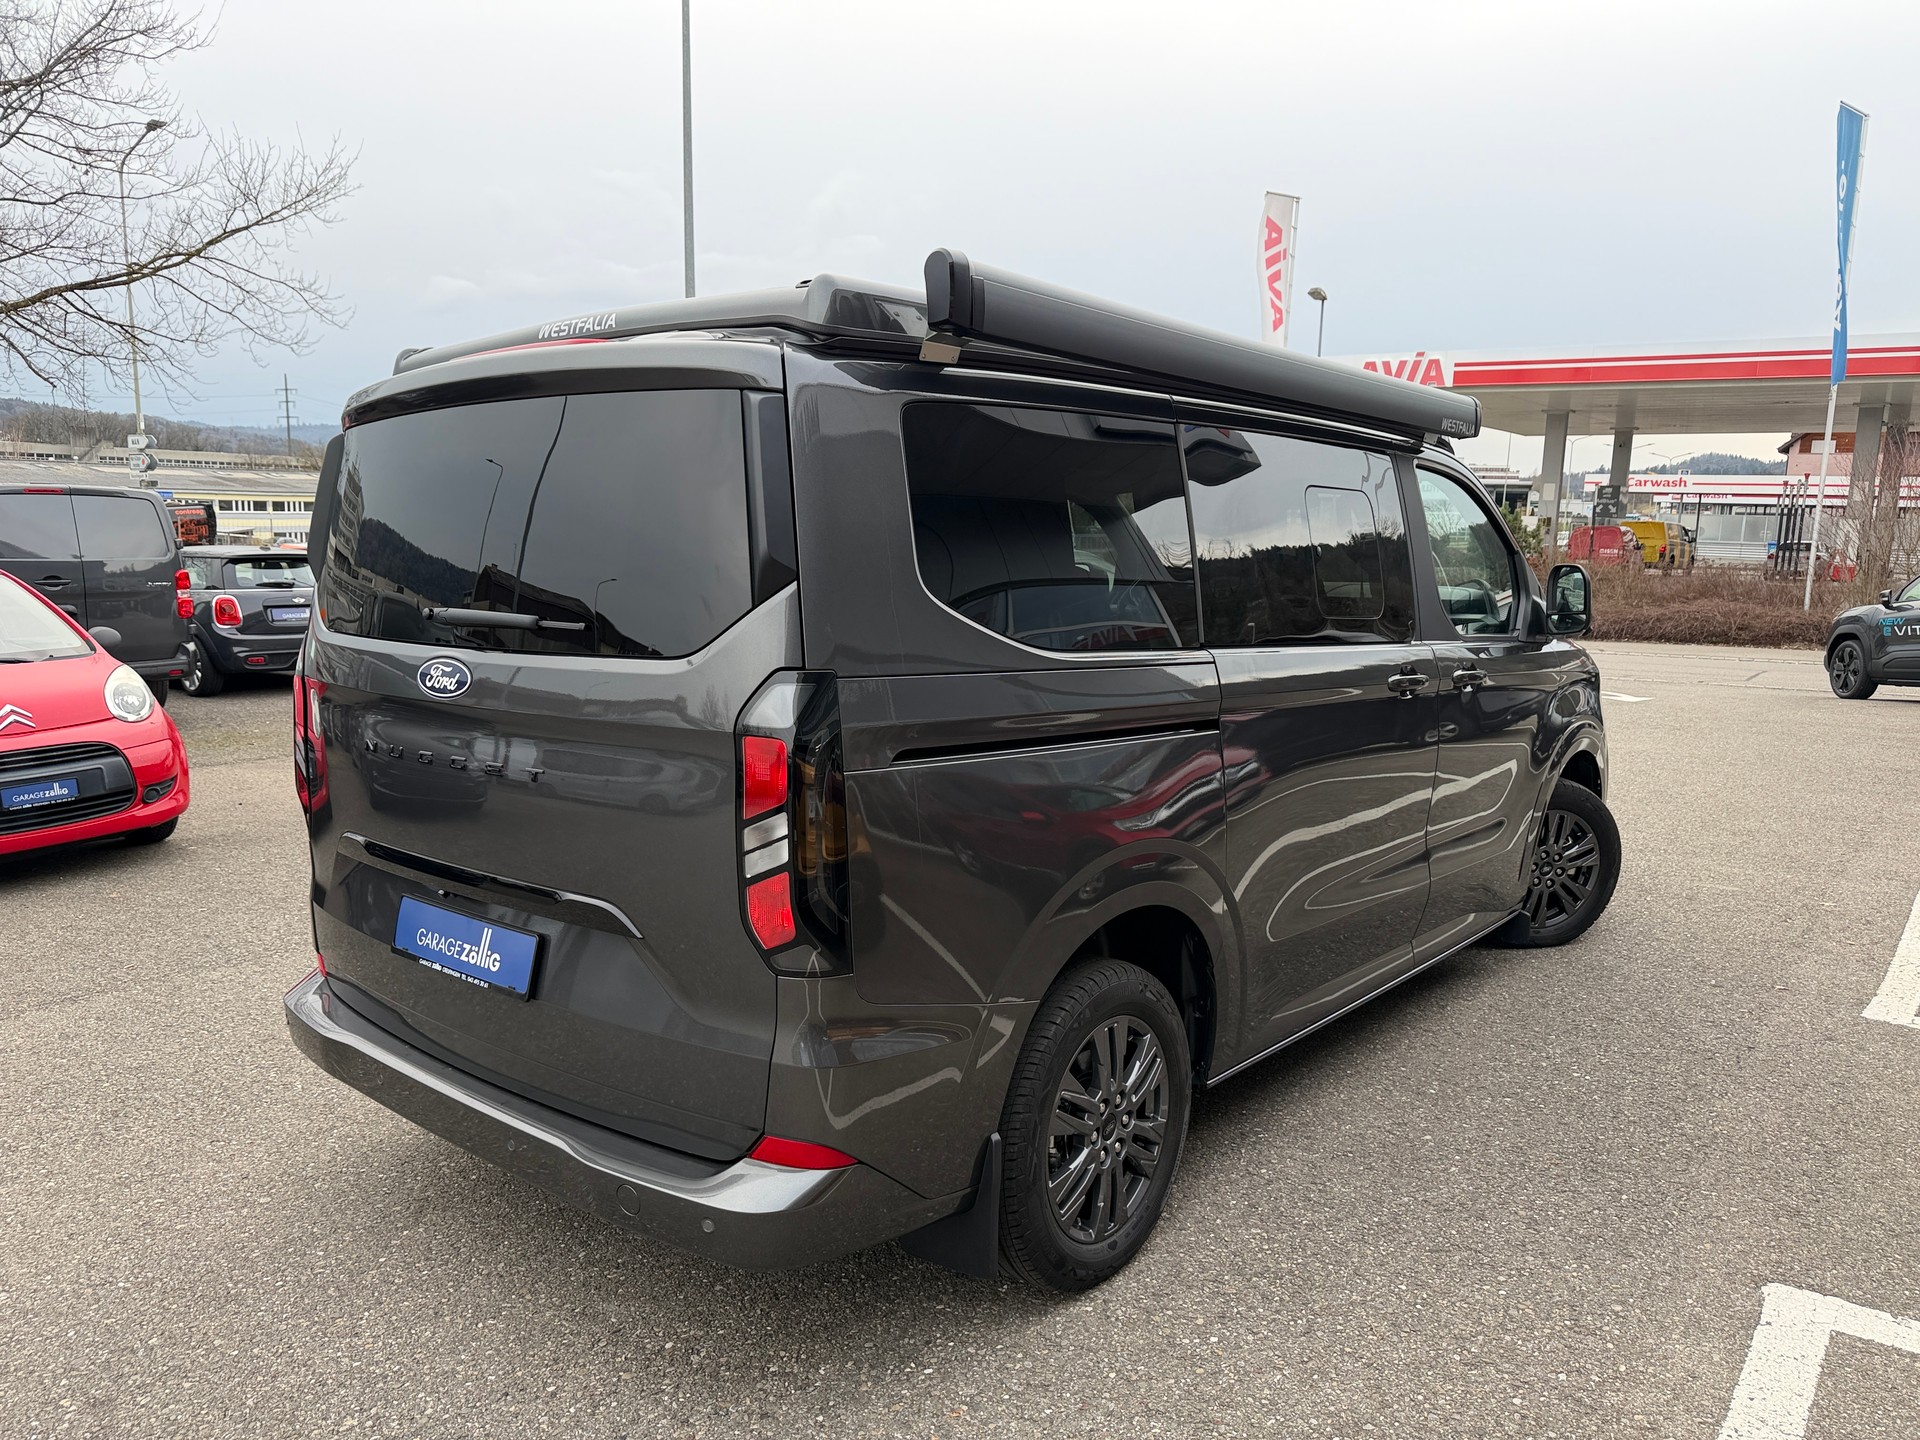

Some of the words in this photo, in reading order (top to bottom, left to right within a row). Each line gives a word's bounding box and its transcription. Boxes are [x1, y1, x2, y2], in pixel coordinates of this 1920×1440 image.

[538, 313, 617, 339] WESTFALIA
[1441, 417, 1475, 436] WESTFALIA
[1628, 476, 1688, 488] Carwash
[1879, 617, 1906, 625] NEW
[425, 663, 461, 691] Ford
[365, 739, 546, 783] NUGGET
